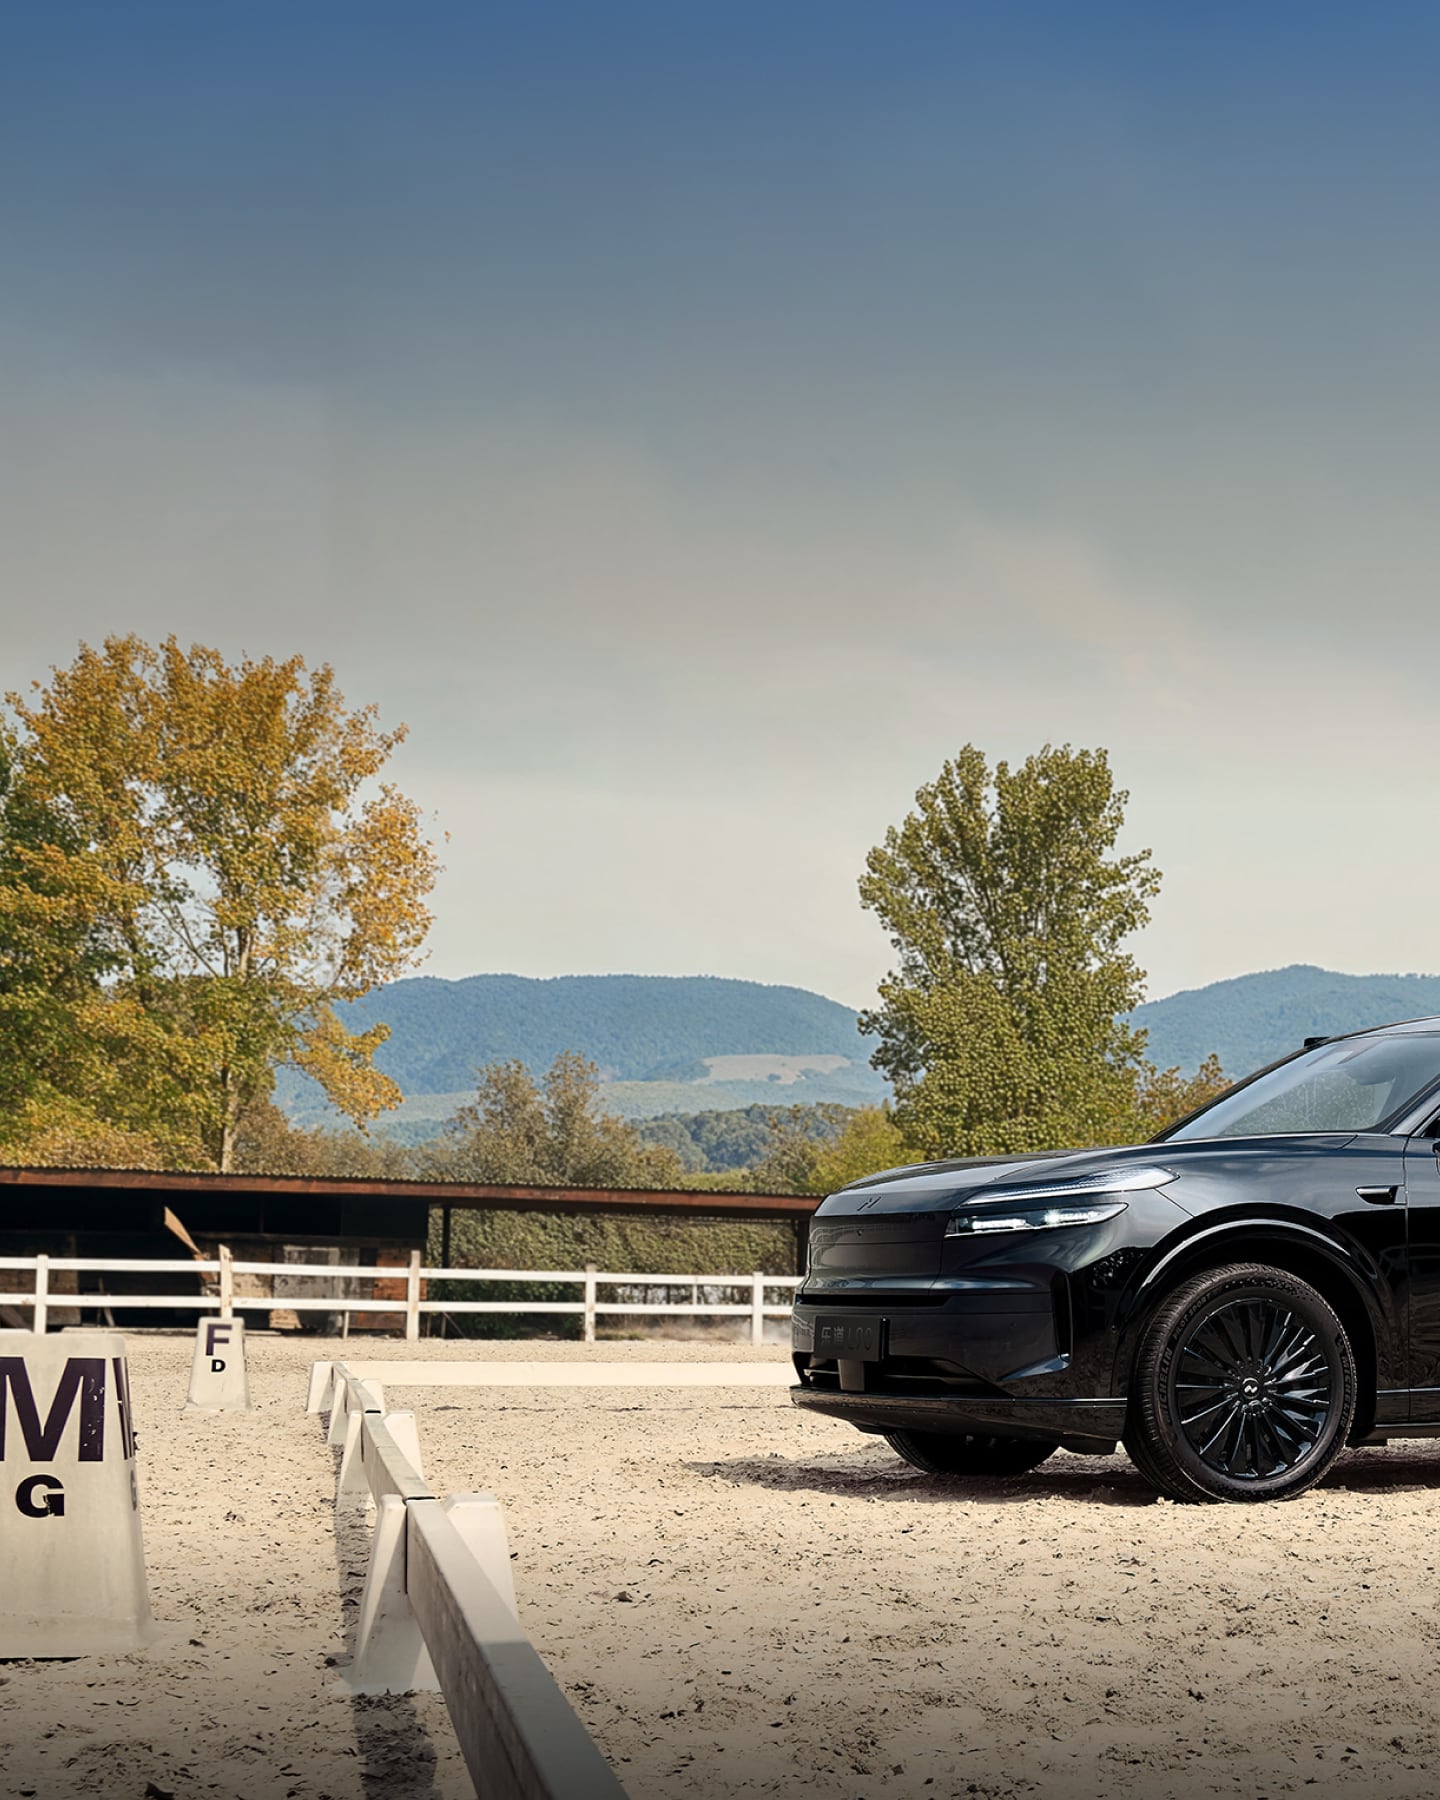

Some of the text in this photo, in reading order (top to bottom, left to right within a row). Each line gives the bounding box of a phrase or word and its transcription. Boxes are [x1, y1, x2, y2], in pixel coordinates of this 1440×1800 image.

[206, 1324, 232, 1355] F
[211, 1359, 226, 1372] D
[0, 1357, 106, 1462] M
[15, 1474, 64, 1518] G
